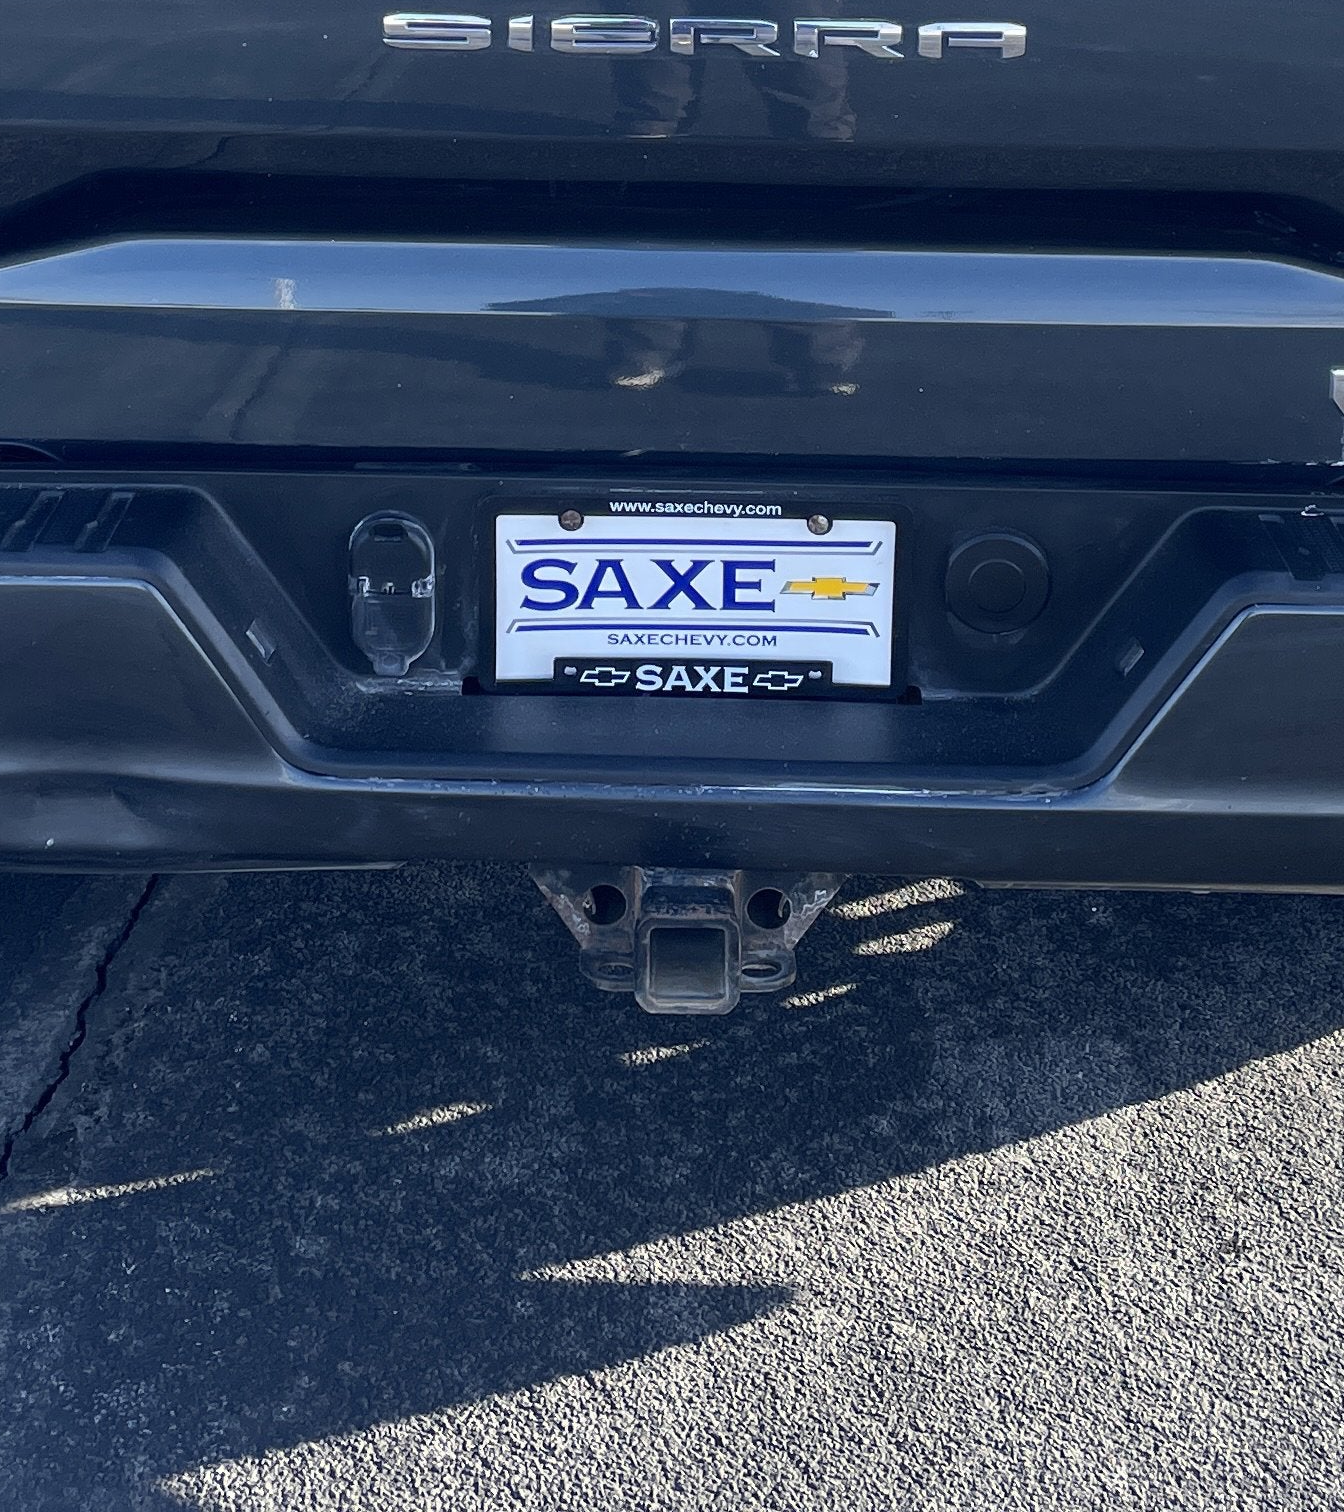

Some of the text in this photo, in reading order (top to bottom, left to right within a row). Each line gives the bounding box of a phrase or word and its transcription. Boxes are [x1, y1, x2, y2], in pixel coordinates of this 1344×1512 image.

[381, 12, 1028, 60] SIERRA
[609, 500, 783, 518] www.saxechevy.com
[519, 557, 777, 613] SAXE
[607, 632, 778, 647] SAXECHEVY.COM
[635, 664, 750, 694] SAXE
